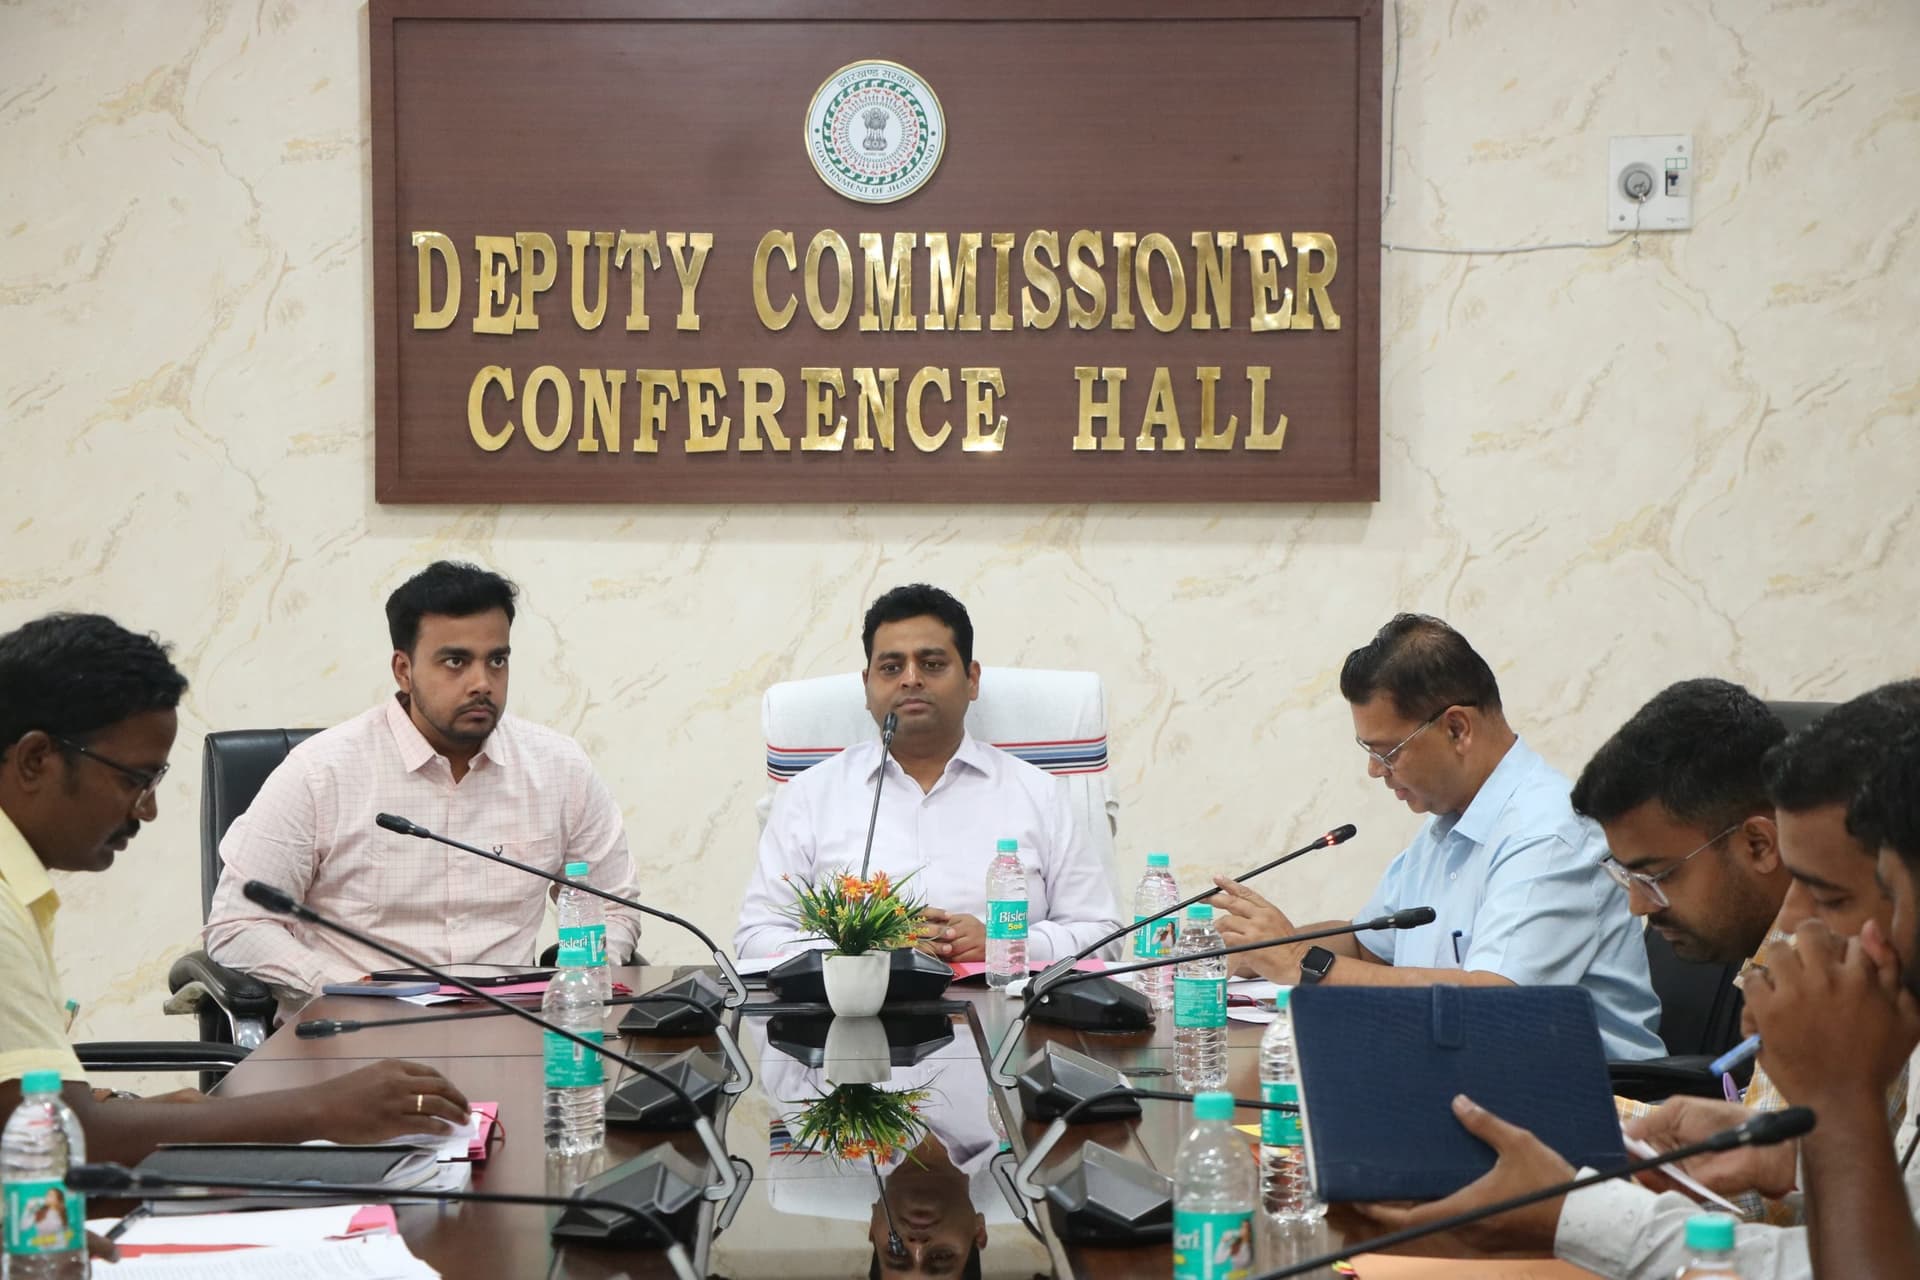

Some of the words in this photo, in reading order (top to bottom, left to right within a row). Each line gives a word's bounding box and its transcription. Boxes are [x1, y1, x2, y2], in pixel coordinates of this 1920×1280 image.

[882, 70, 916, 90] सरकार
[814, 140, 868, 194] GOVERNMENT
[871, 186, 884, 195] OF
[887, 143, 936, 193] JHARKHAND
[411, 229, 714, 335] DEPUTY
[752, 229, 1341, 333] COMMISSIONER
[467, 365, 1009, 453] CONFERENCE
[1073, 366, 1289, 451] HALL
